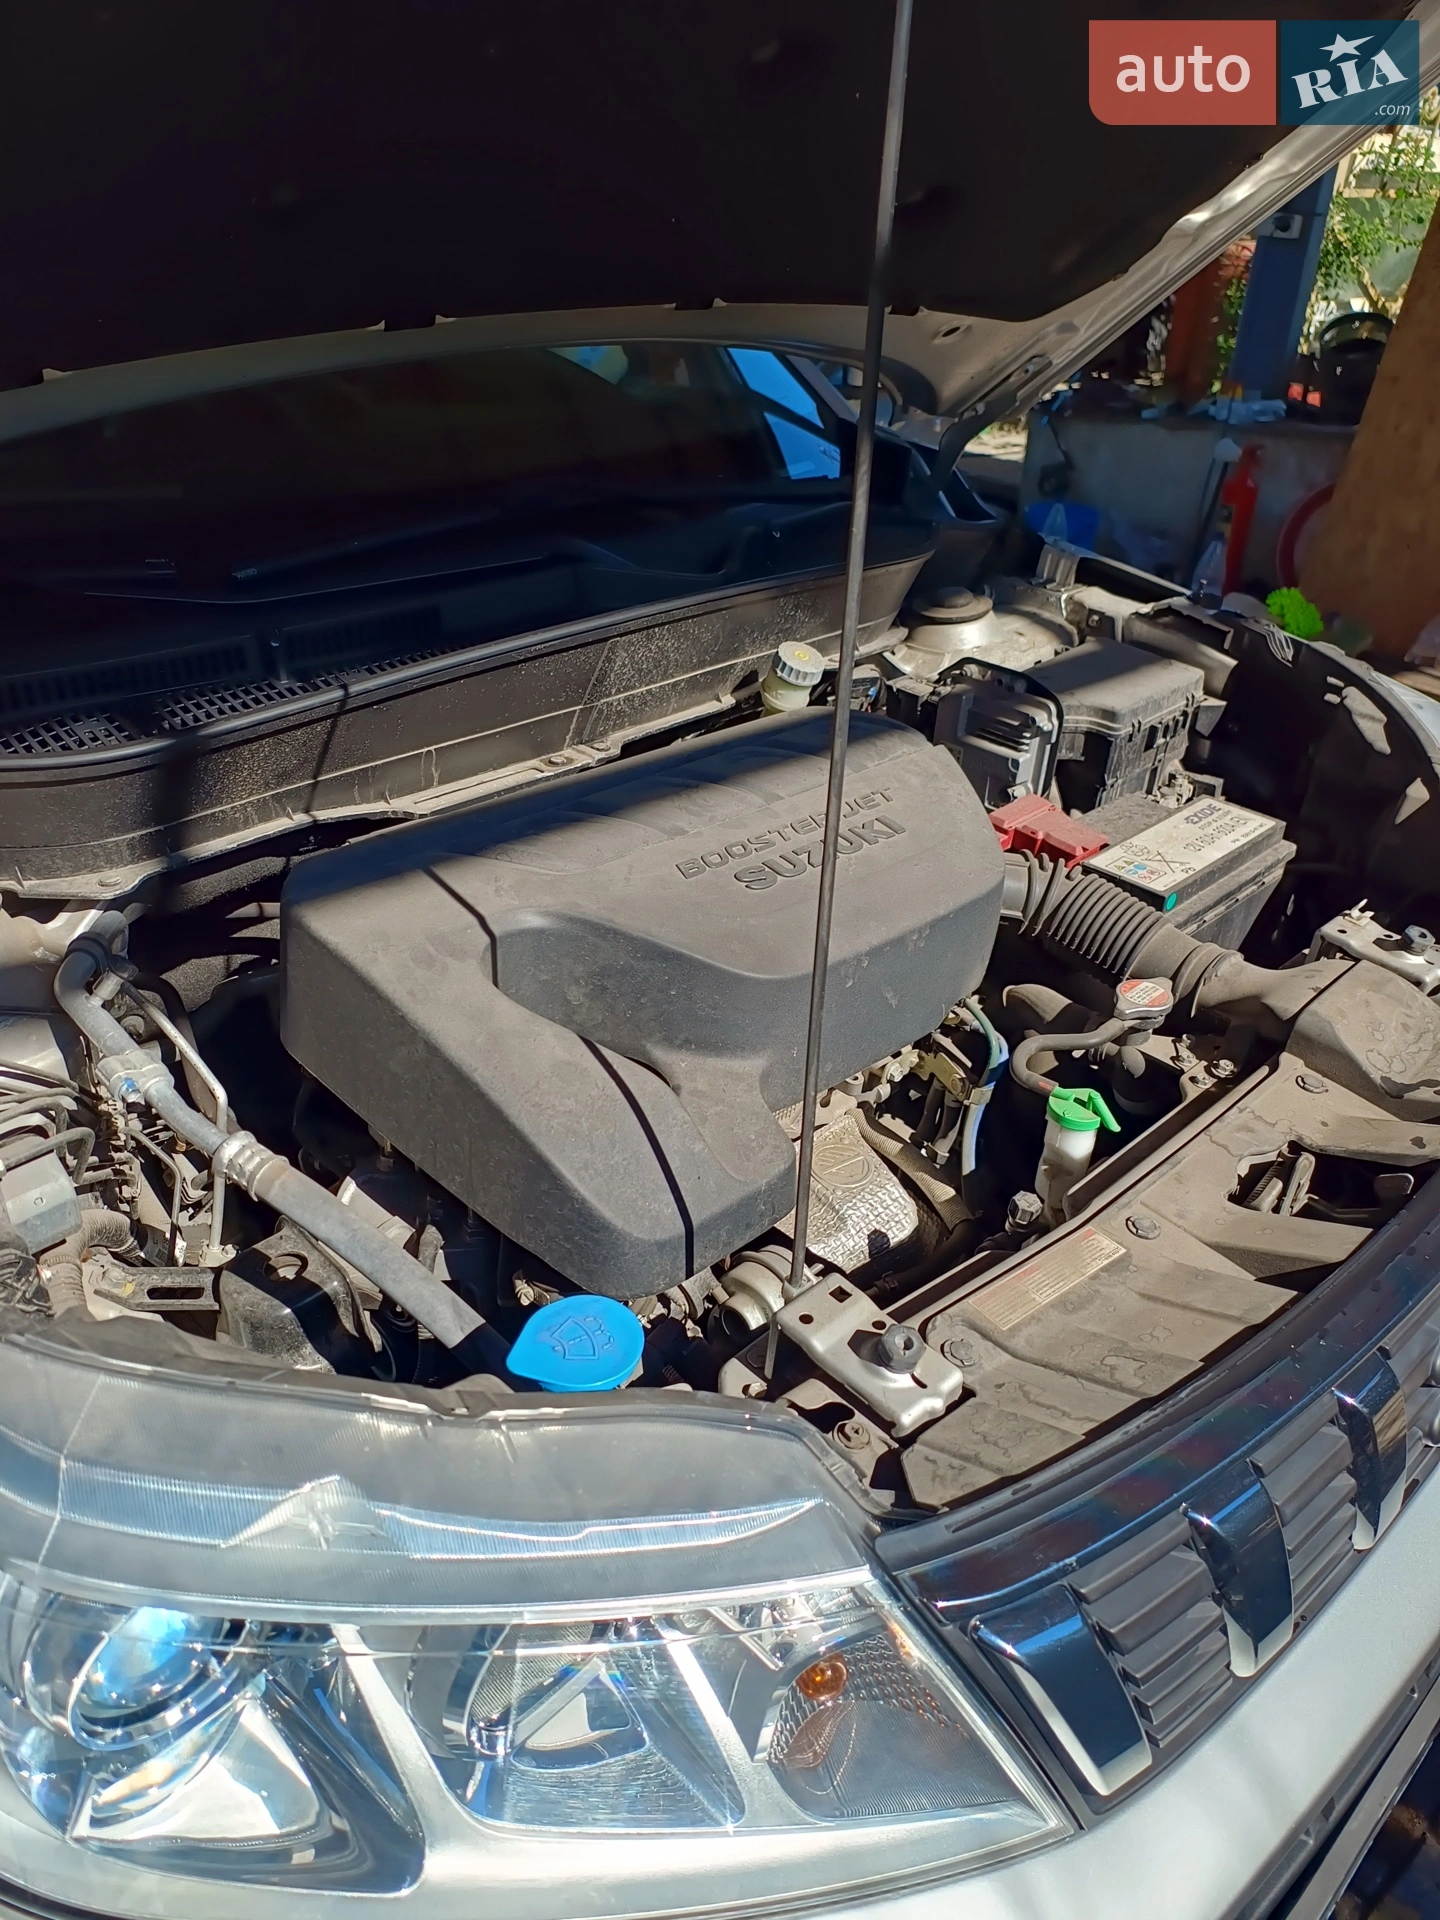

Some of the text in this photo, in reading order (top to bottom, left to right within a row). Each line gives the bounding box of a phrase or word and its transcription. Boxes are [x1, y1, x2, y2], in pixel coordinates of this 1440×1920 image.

[1184, 804, 1222, 825] EXIDE
[734, 815, 906, 890] SUZUKI
[1181, 867, 1196, 875] Pb
